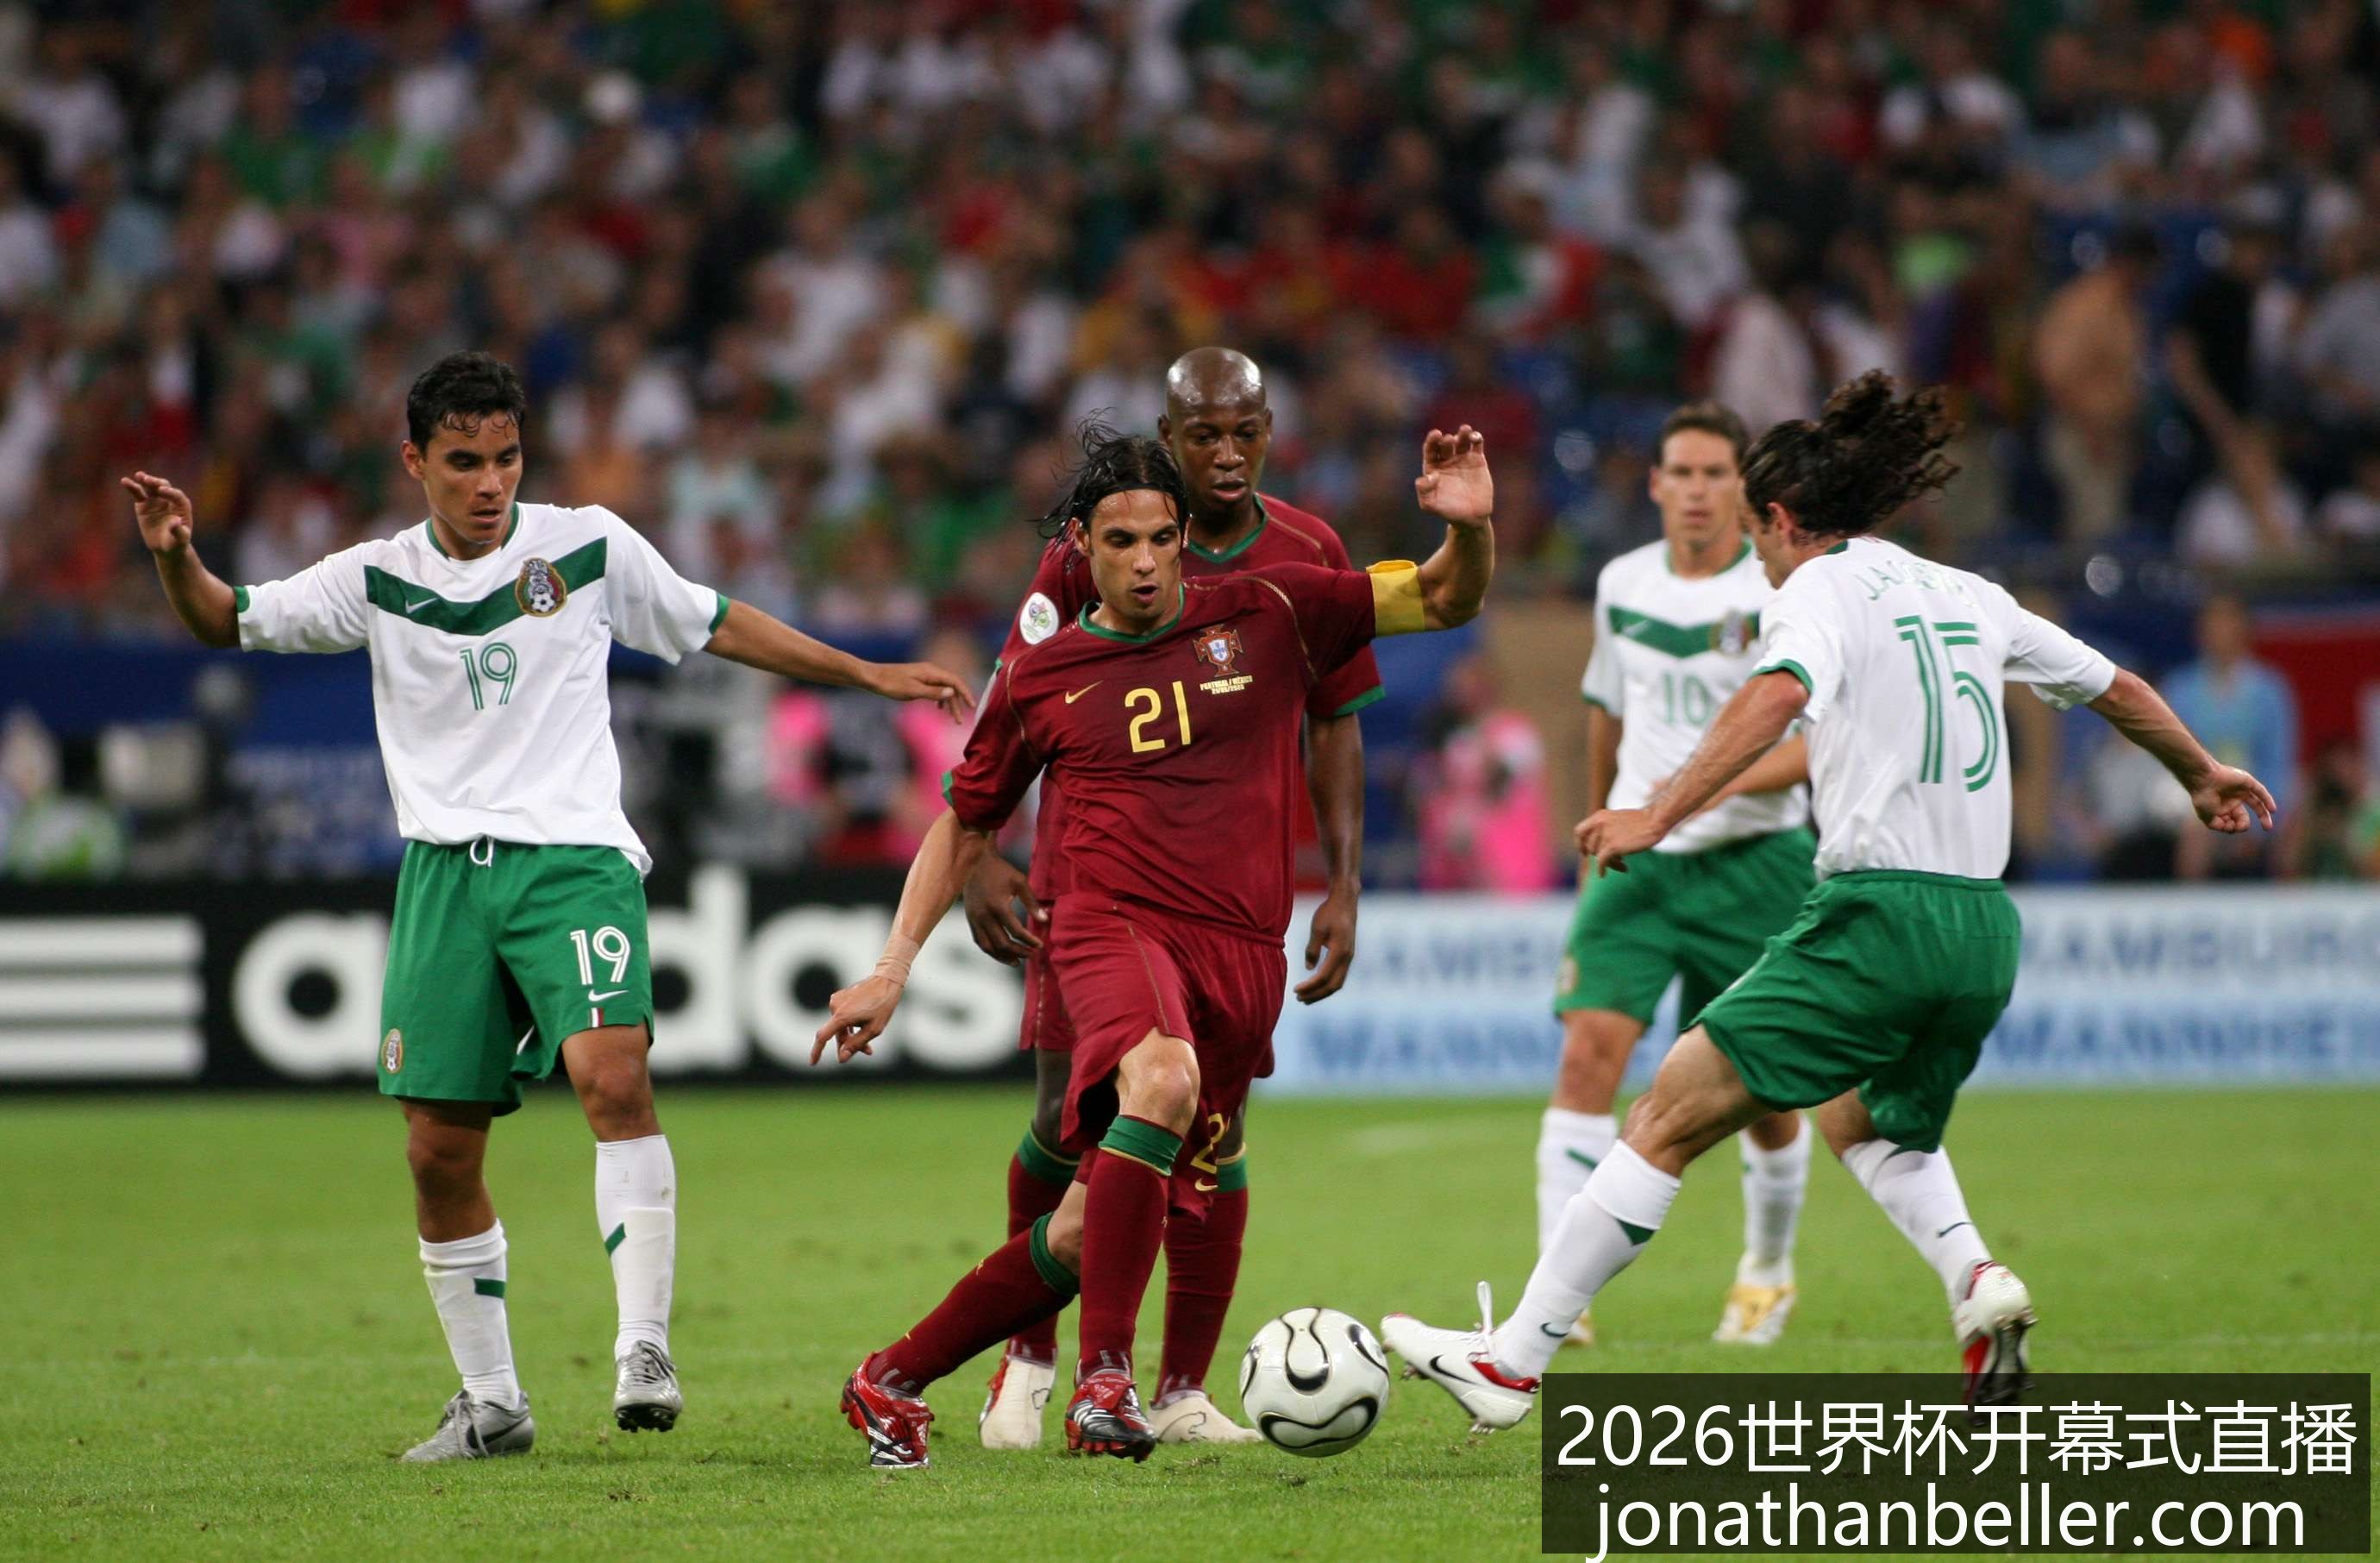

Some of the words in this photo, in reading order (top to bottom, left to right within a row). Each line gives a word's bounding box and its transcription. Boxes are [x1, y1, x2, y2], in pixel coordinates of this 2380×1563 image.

[460, 642, 517, 710] 19
[1661, 671, 1713, 725] 10
[1895, 615, 1998, 793] 15
[1124, 681, 1192, 753] 21
[234, 866, 1029, 1077] adas
[569, 925, 631, 985] 19
